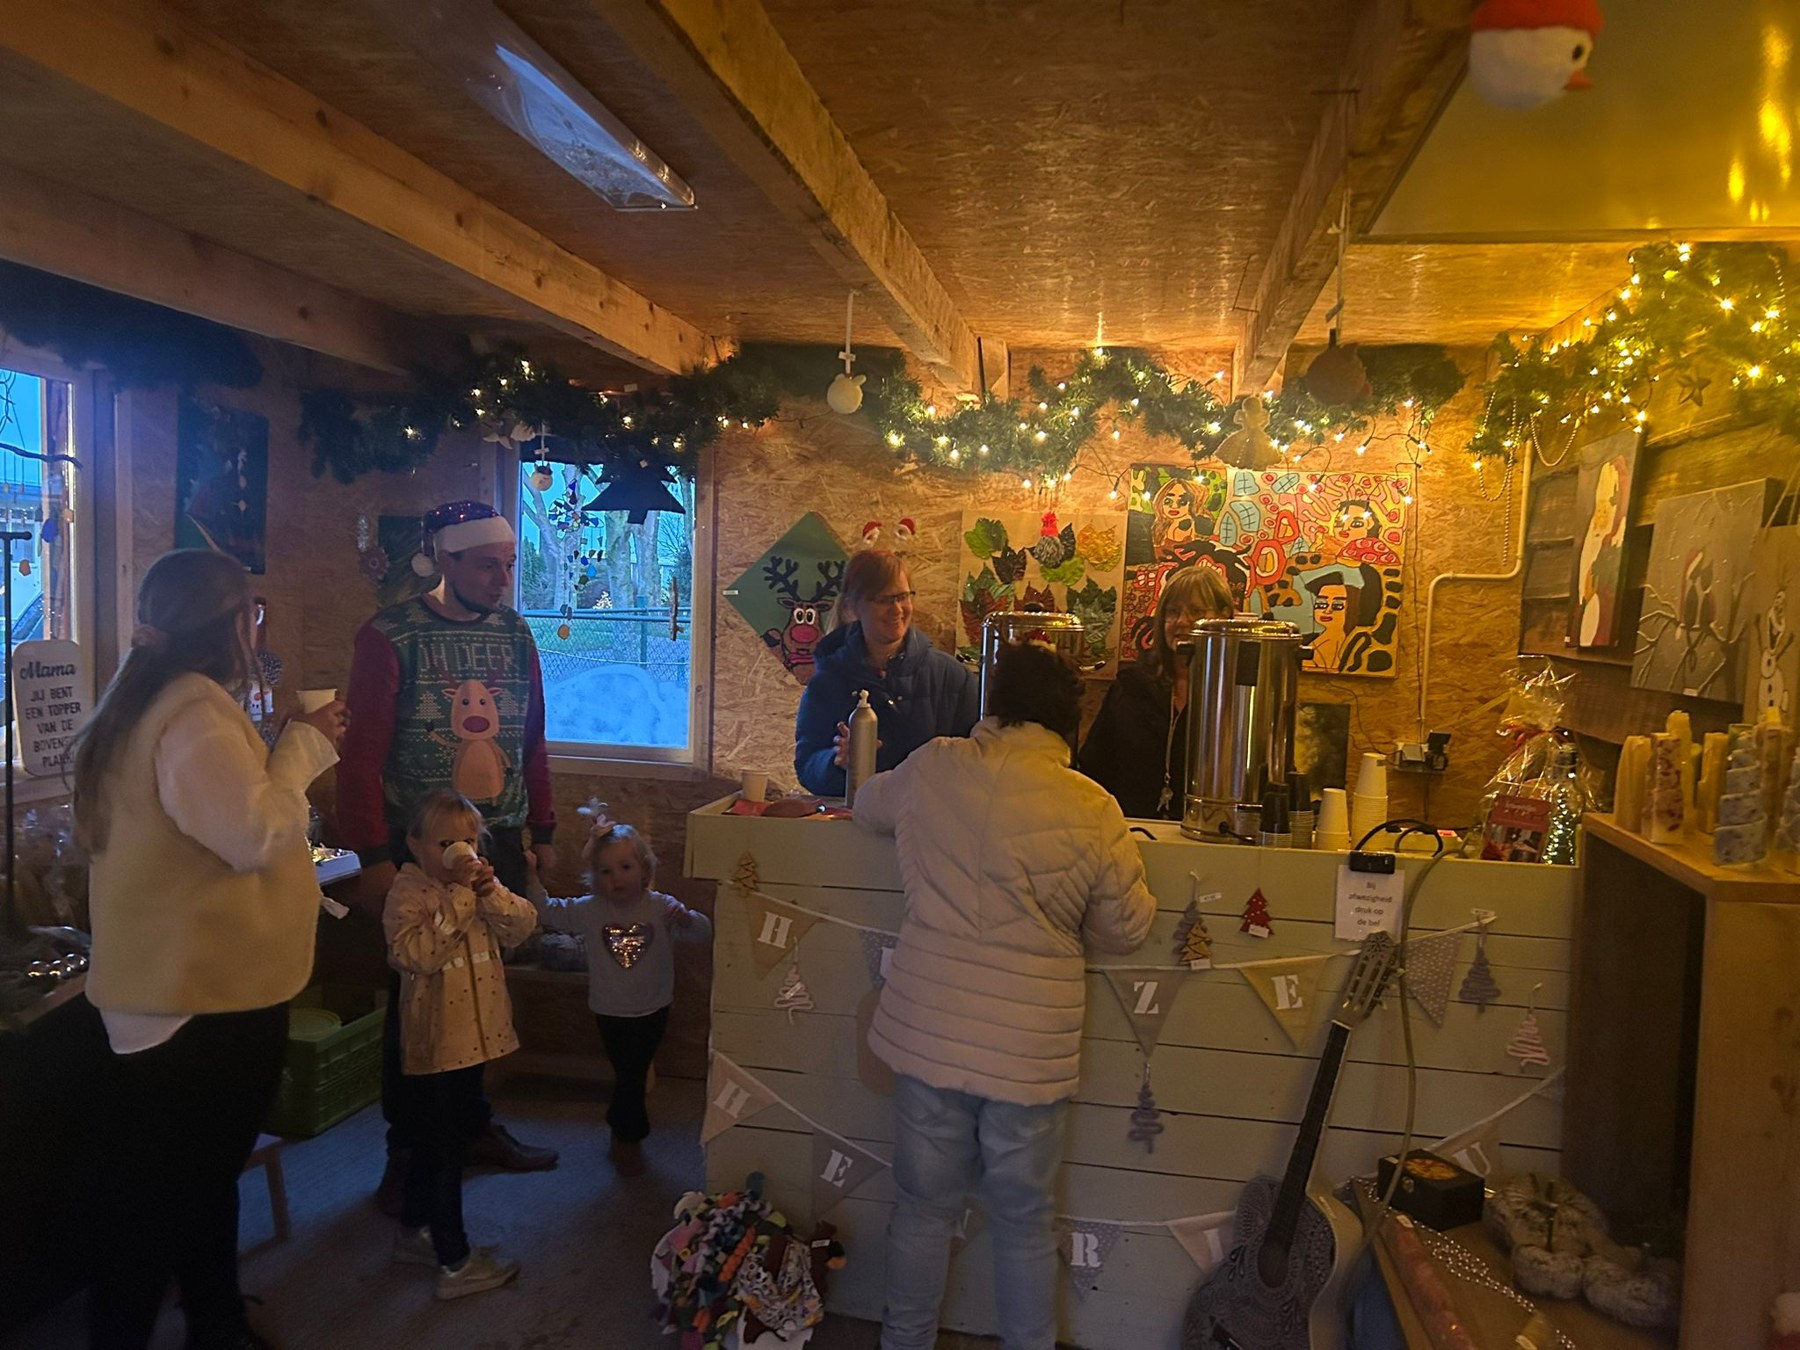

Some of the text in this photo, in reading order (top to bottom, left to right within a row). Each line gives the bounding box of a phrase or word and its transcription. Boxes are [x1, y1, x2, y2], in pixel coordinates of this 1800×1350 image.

[453, 642, 520, 671] DEER
[20, 660, 77, 680] Mama
[30, 686, 73, 702] JIJ BENT
[25, 701, 82, 719] EEN TOPPER
[37, 719, 74, 735] VAN DE
[1355, 905, 1384, 917] druk op
[1356, 917, 1367, 926] de
[757, 911, 1304, 1015] H Z E
[820, 1149, 853, 1188] E
[1070, 1231, 1102, 1269] R
